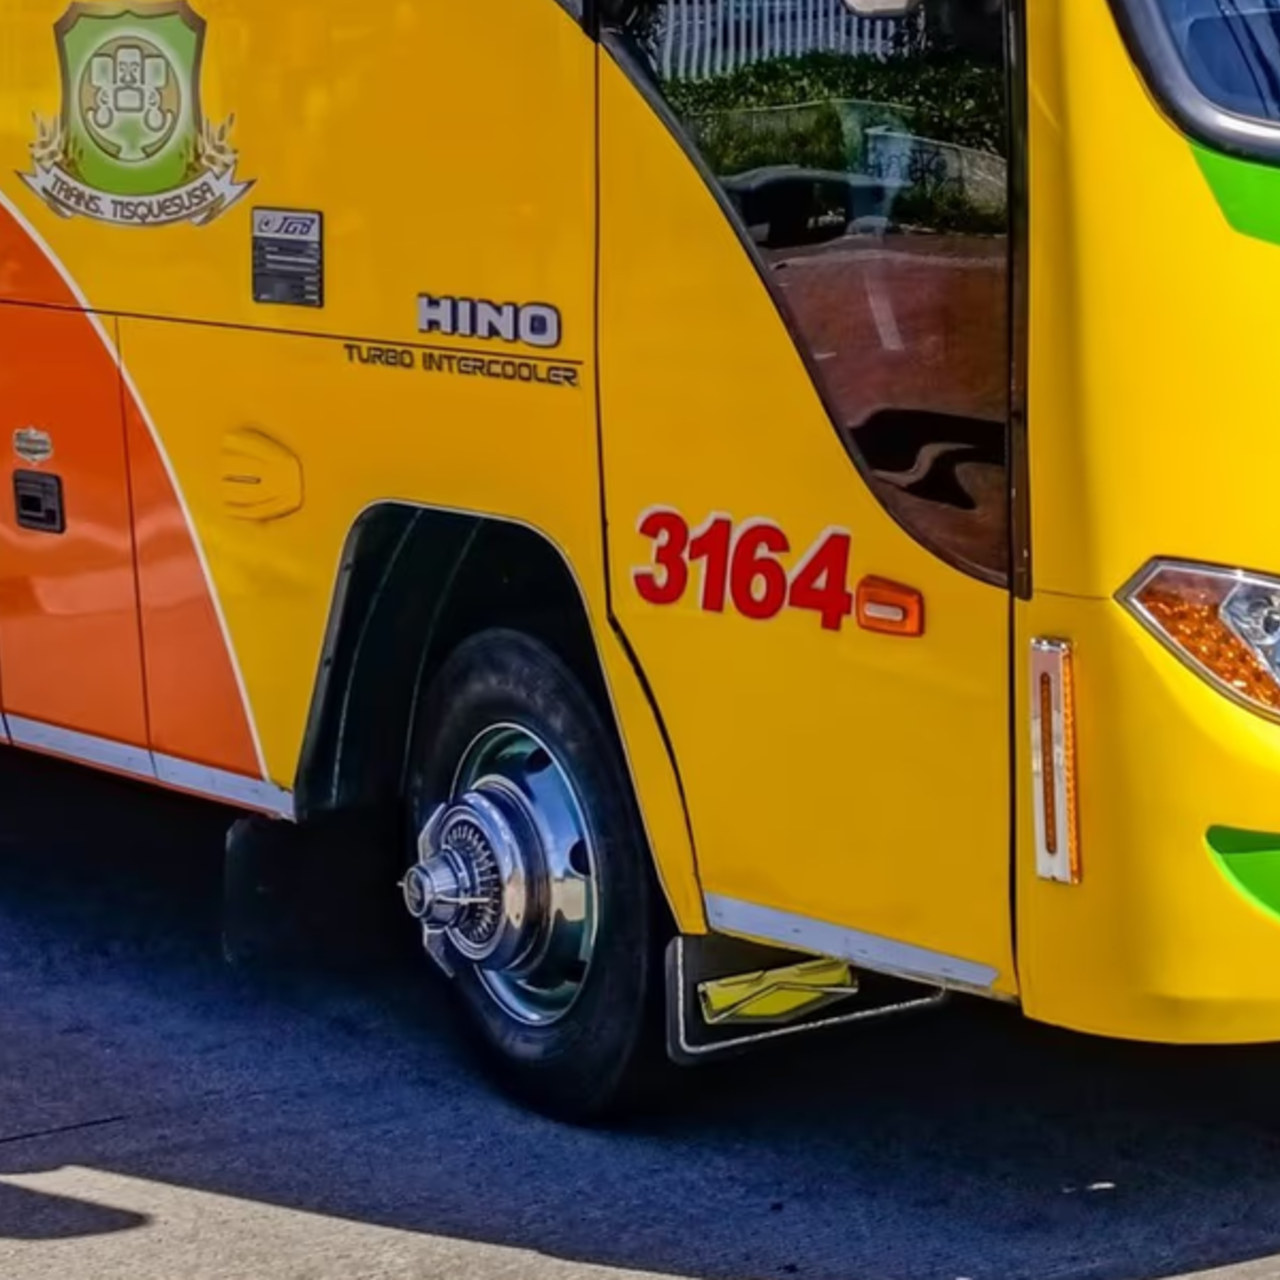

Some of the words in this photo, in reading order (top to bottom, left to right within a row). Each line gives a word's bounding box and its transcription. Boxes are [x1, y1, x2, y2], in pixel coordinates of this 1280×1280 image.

[110, 181, 216, 224] TISQUESUSA
[417, 292, 562, 349] HINO
[343, 343, 415, 369] TURBO
[422, 352, 581, 387] INTERCOOLER
[631, 503, 854, 632] 3164
